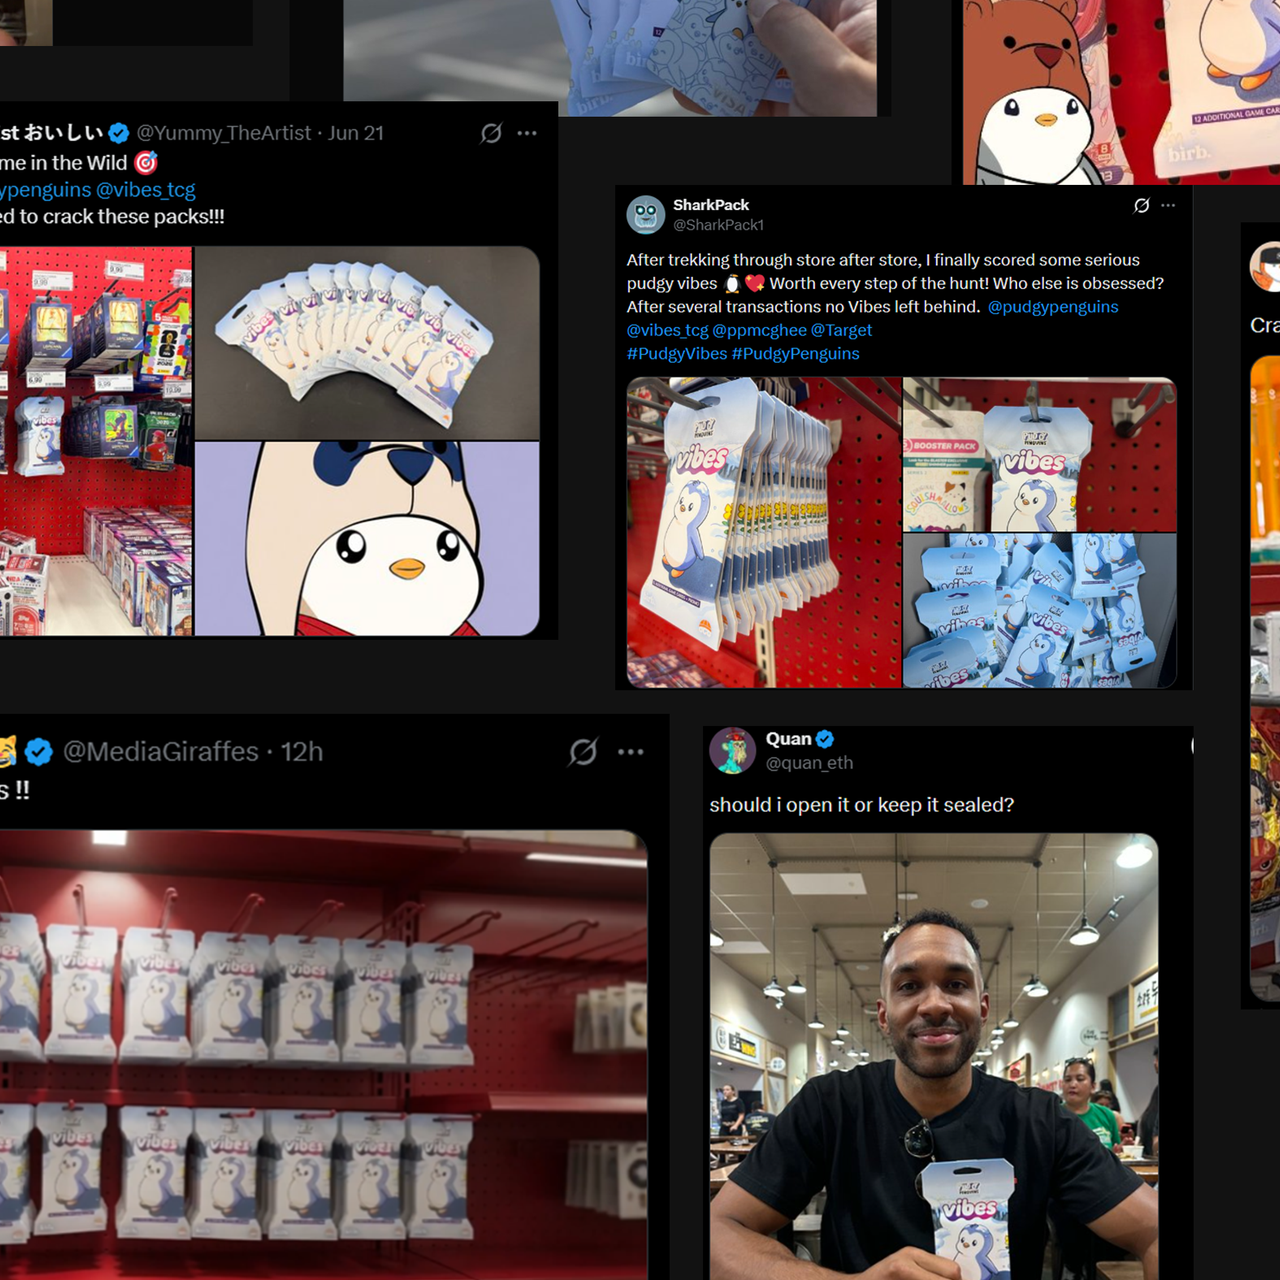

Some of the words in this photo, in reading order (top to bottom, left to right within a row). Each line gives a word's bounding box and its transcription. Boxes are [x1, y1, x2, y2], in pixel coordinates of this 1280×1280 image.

[23, 123, 104, 142] おいしい
[673, 198, 750, 211] SharkPack
[913, 442, 949, 450] BOOSTER
[952, 442, 977, 450] PACK
[677, 443, 729, 475] vibes
[1003, 449, 1065, 475] vibes
[15, 779, 30, 800] !!
